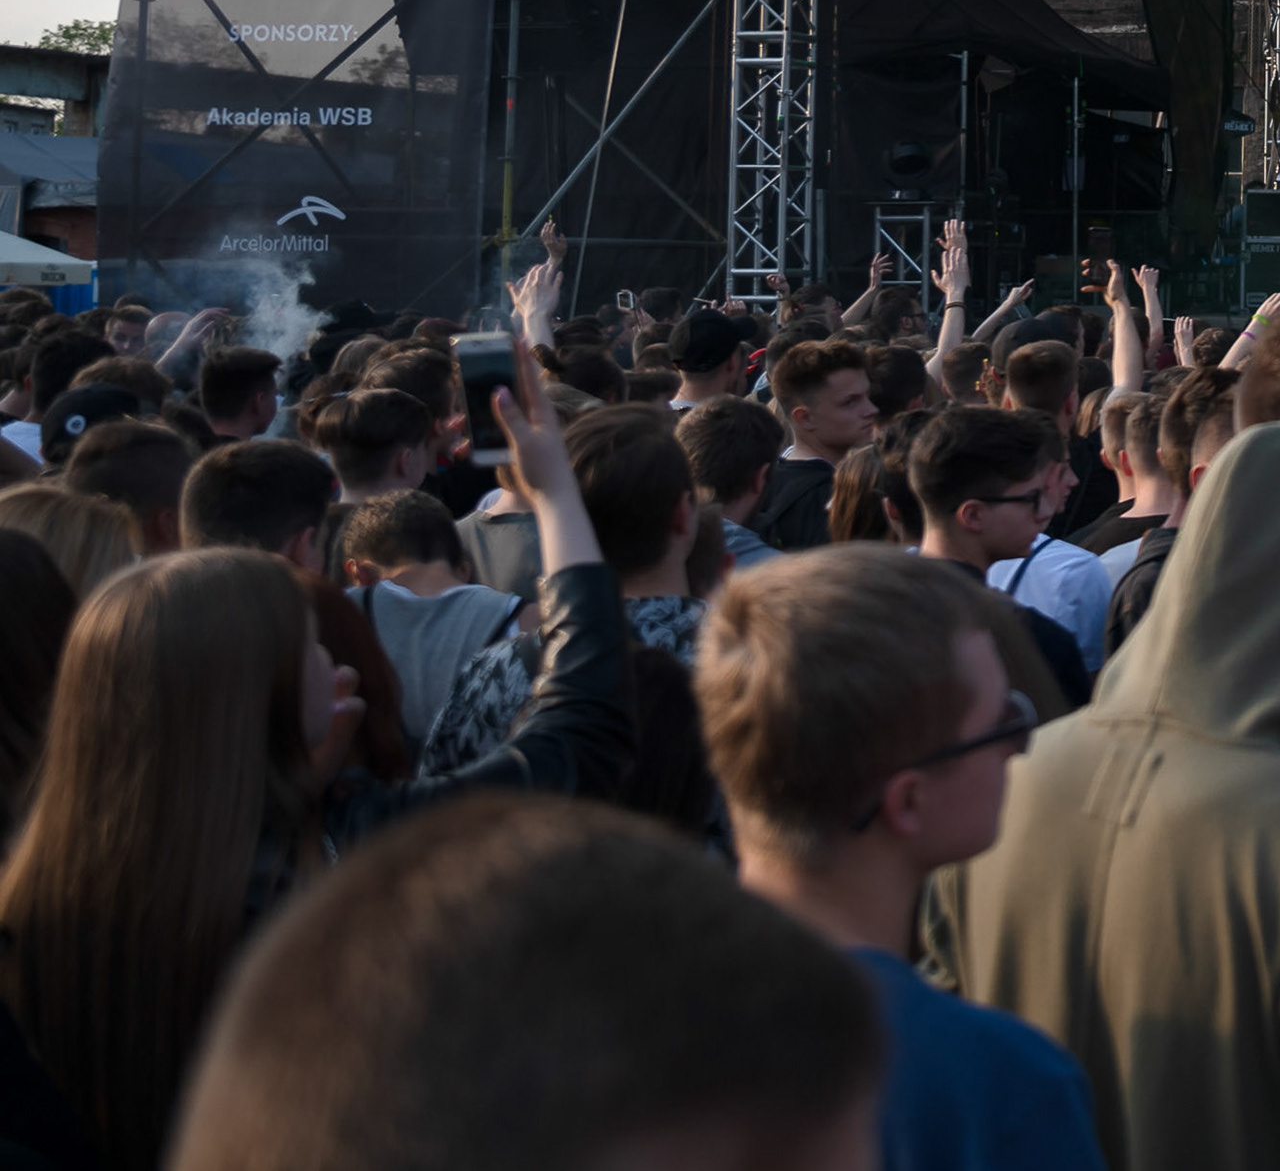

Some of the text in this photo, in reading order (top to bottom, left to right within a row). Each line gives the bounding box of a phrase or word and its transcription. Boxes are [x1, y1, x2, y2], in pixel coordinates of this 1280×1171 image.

[228, 24, 359, 42] SPONSORZY:
[206, 107, 373, 126] Akademia WSB
[219, 234, 330, 252] ArcelorMittal
